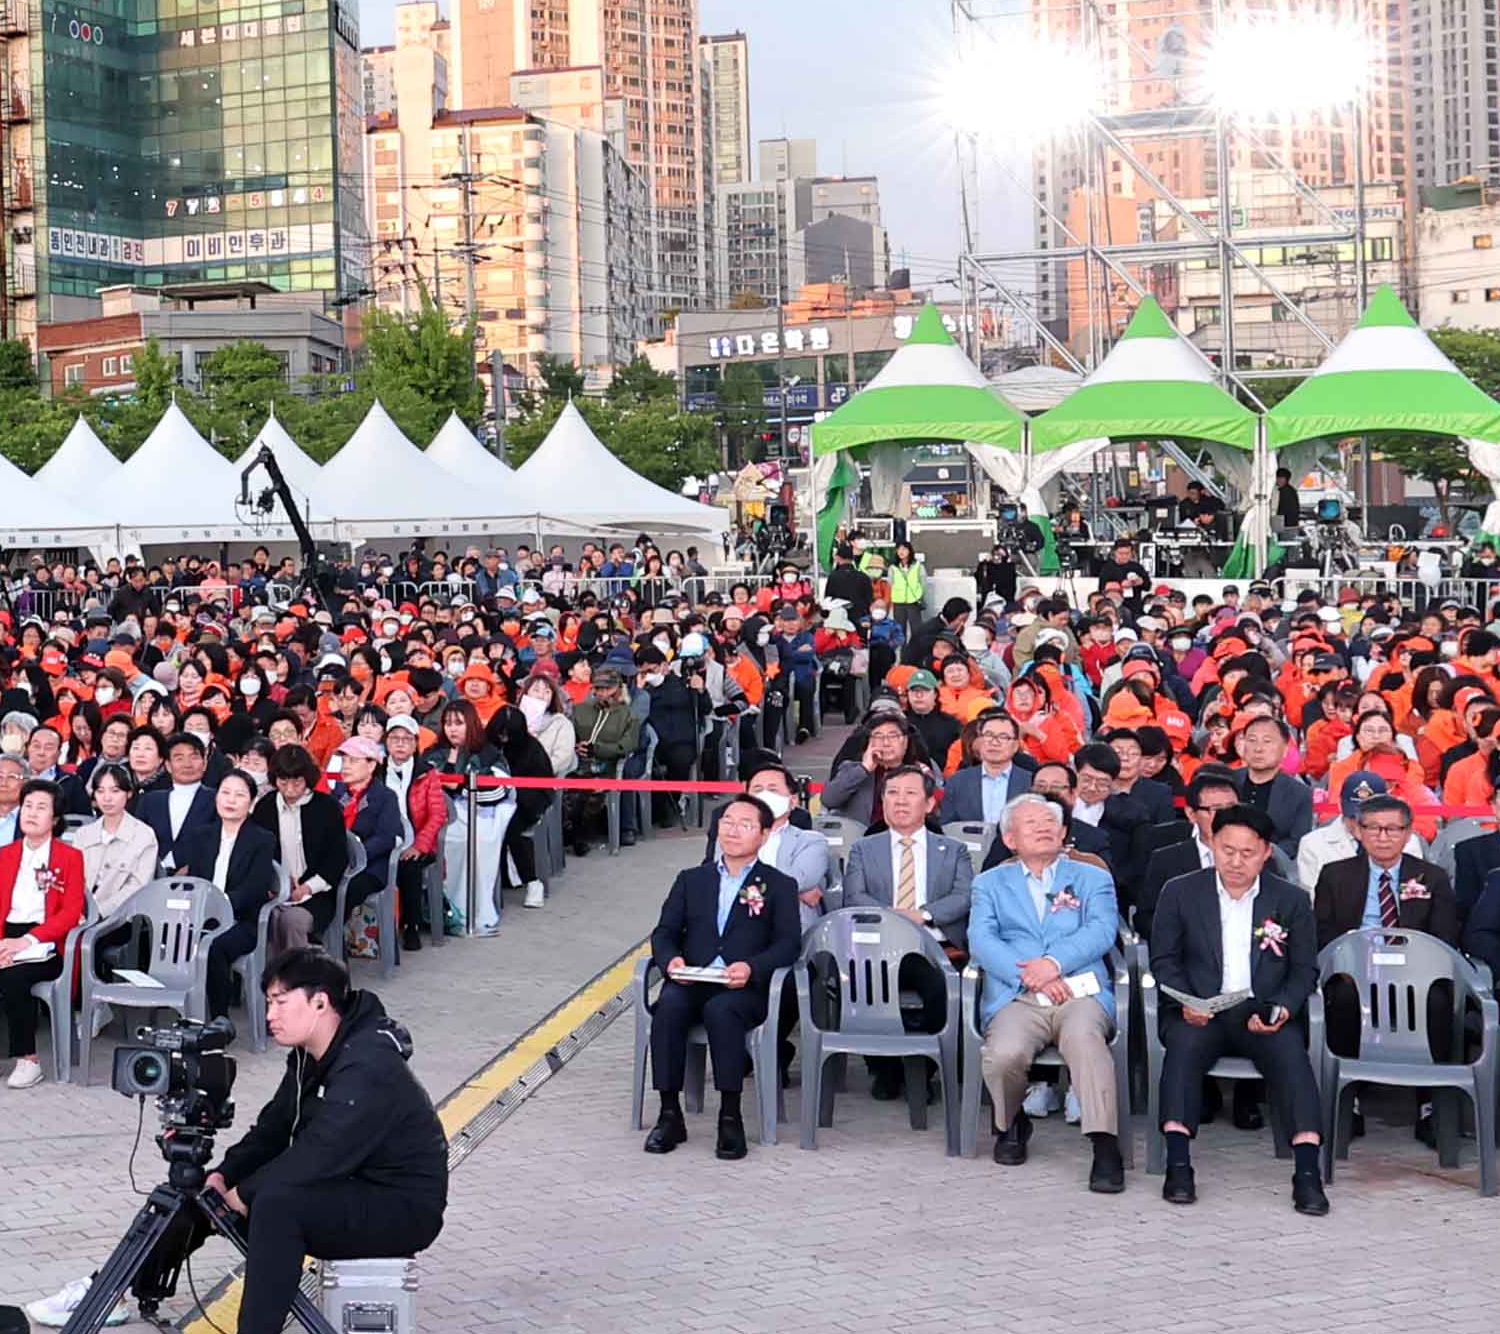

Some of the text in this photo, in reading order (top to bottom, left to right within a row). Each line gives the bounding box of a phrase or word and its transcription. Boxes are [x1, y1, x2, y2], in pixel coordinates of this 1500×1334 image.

[50, 231, 110, 257] 동인천내과
[186, 231, 287, 257] 이비인후과
[737, 327, 831, 356] 다은학원
